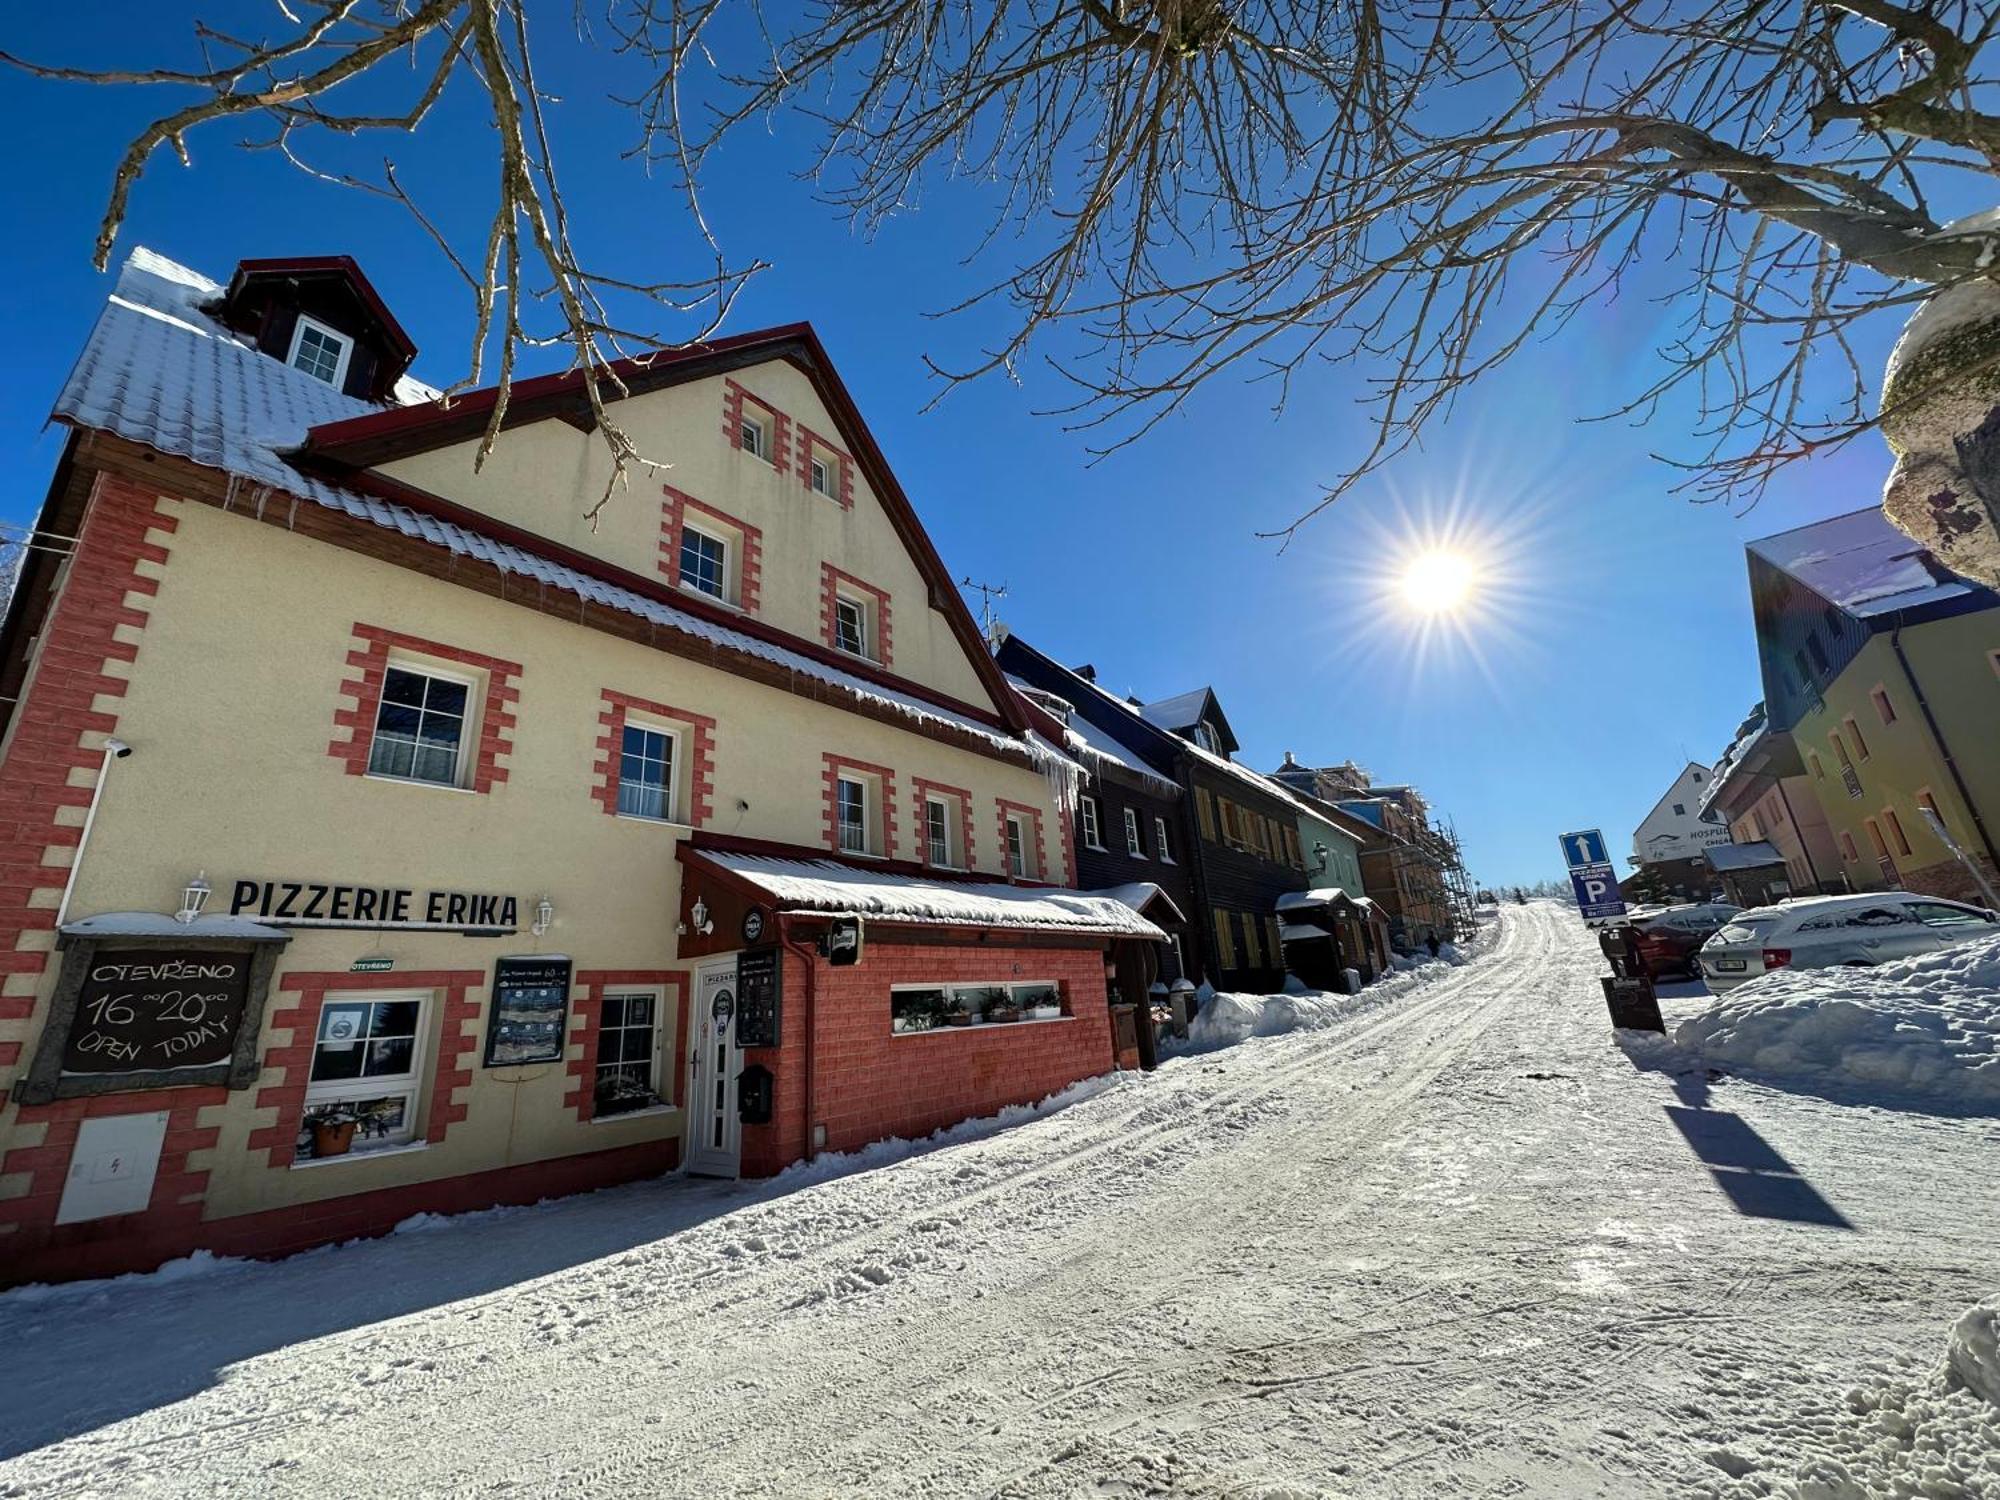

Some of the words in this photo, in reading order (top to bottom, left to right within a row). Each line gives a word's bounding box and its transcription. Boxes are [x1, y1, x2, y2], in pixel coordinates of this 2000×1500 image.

[230, 880, 412, 921] PIZZERIE
[426, 891, 517, 926] ERIKA
[1585, 880, 1606, 903] P
[92, 959, 236, 982] OTEVŘENO
[77, 1030, 141, 1061] OPEN
[152, 1015, 228, 1058] TODAY
